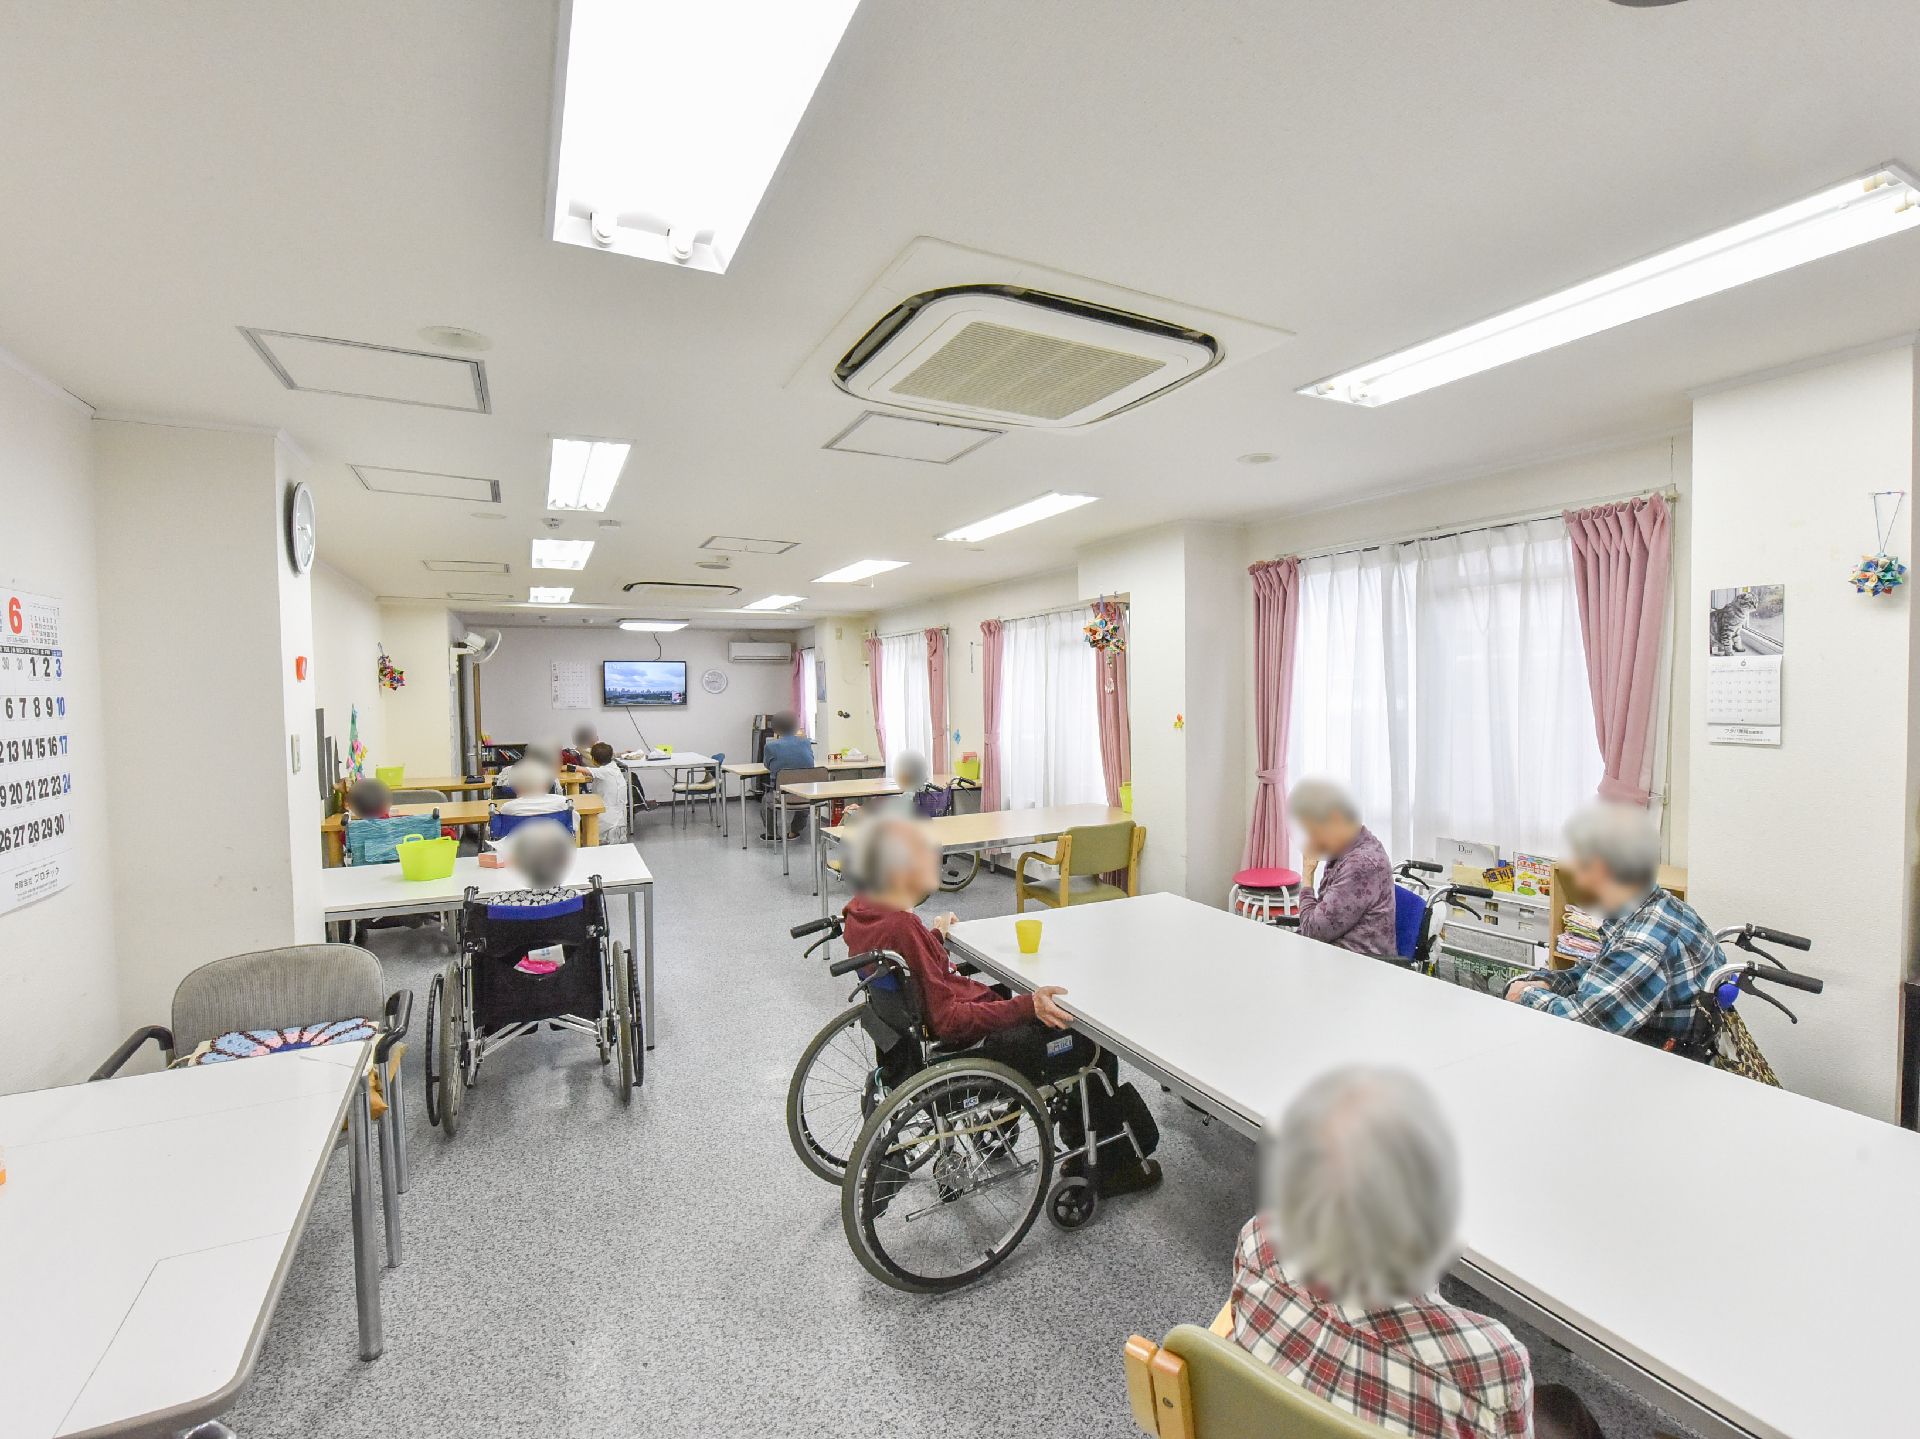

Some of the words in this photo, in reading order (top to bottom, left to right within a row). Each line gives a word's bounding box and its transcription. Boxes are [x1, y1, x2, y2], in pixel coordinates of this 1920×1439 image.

[9, 597, 22, 634] 6
[30, 656, 36, 677] 1
[43, 657, 50, 677] 2
[56, 658, 62, 678] 3
[6, 698, 13, 718] 6
[19, 698, 27, 718] 7
[33, 697, 40, 717] 8
[46, 697, 53, 717] 9
[57, 697, 65, 716] 10
[7, 740, 19, 762] 13
[22, 739, 33, 760] 14
[36, 737, 45, 758] 15
[48, 736, 57, 756] 16
[59, 735, 68, 754] 17
[0, 786, 6, 808] 9
[9, 784, 22, 806] 20
[26, 780, 36, 802] 21
[38, 778, 49, 800] 22
[51, 775, 61, 797] 23
[62, 773, 71, 794] 24
[0, 828, 11, 852] 26
[14, 825, 25, 848] 27
[28, 821, 39, 844] 28
[41, 817, 52, 840] 29
[55, 814, 64, 836] 30
